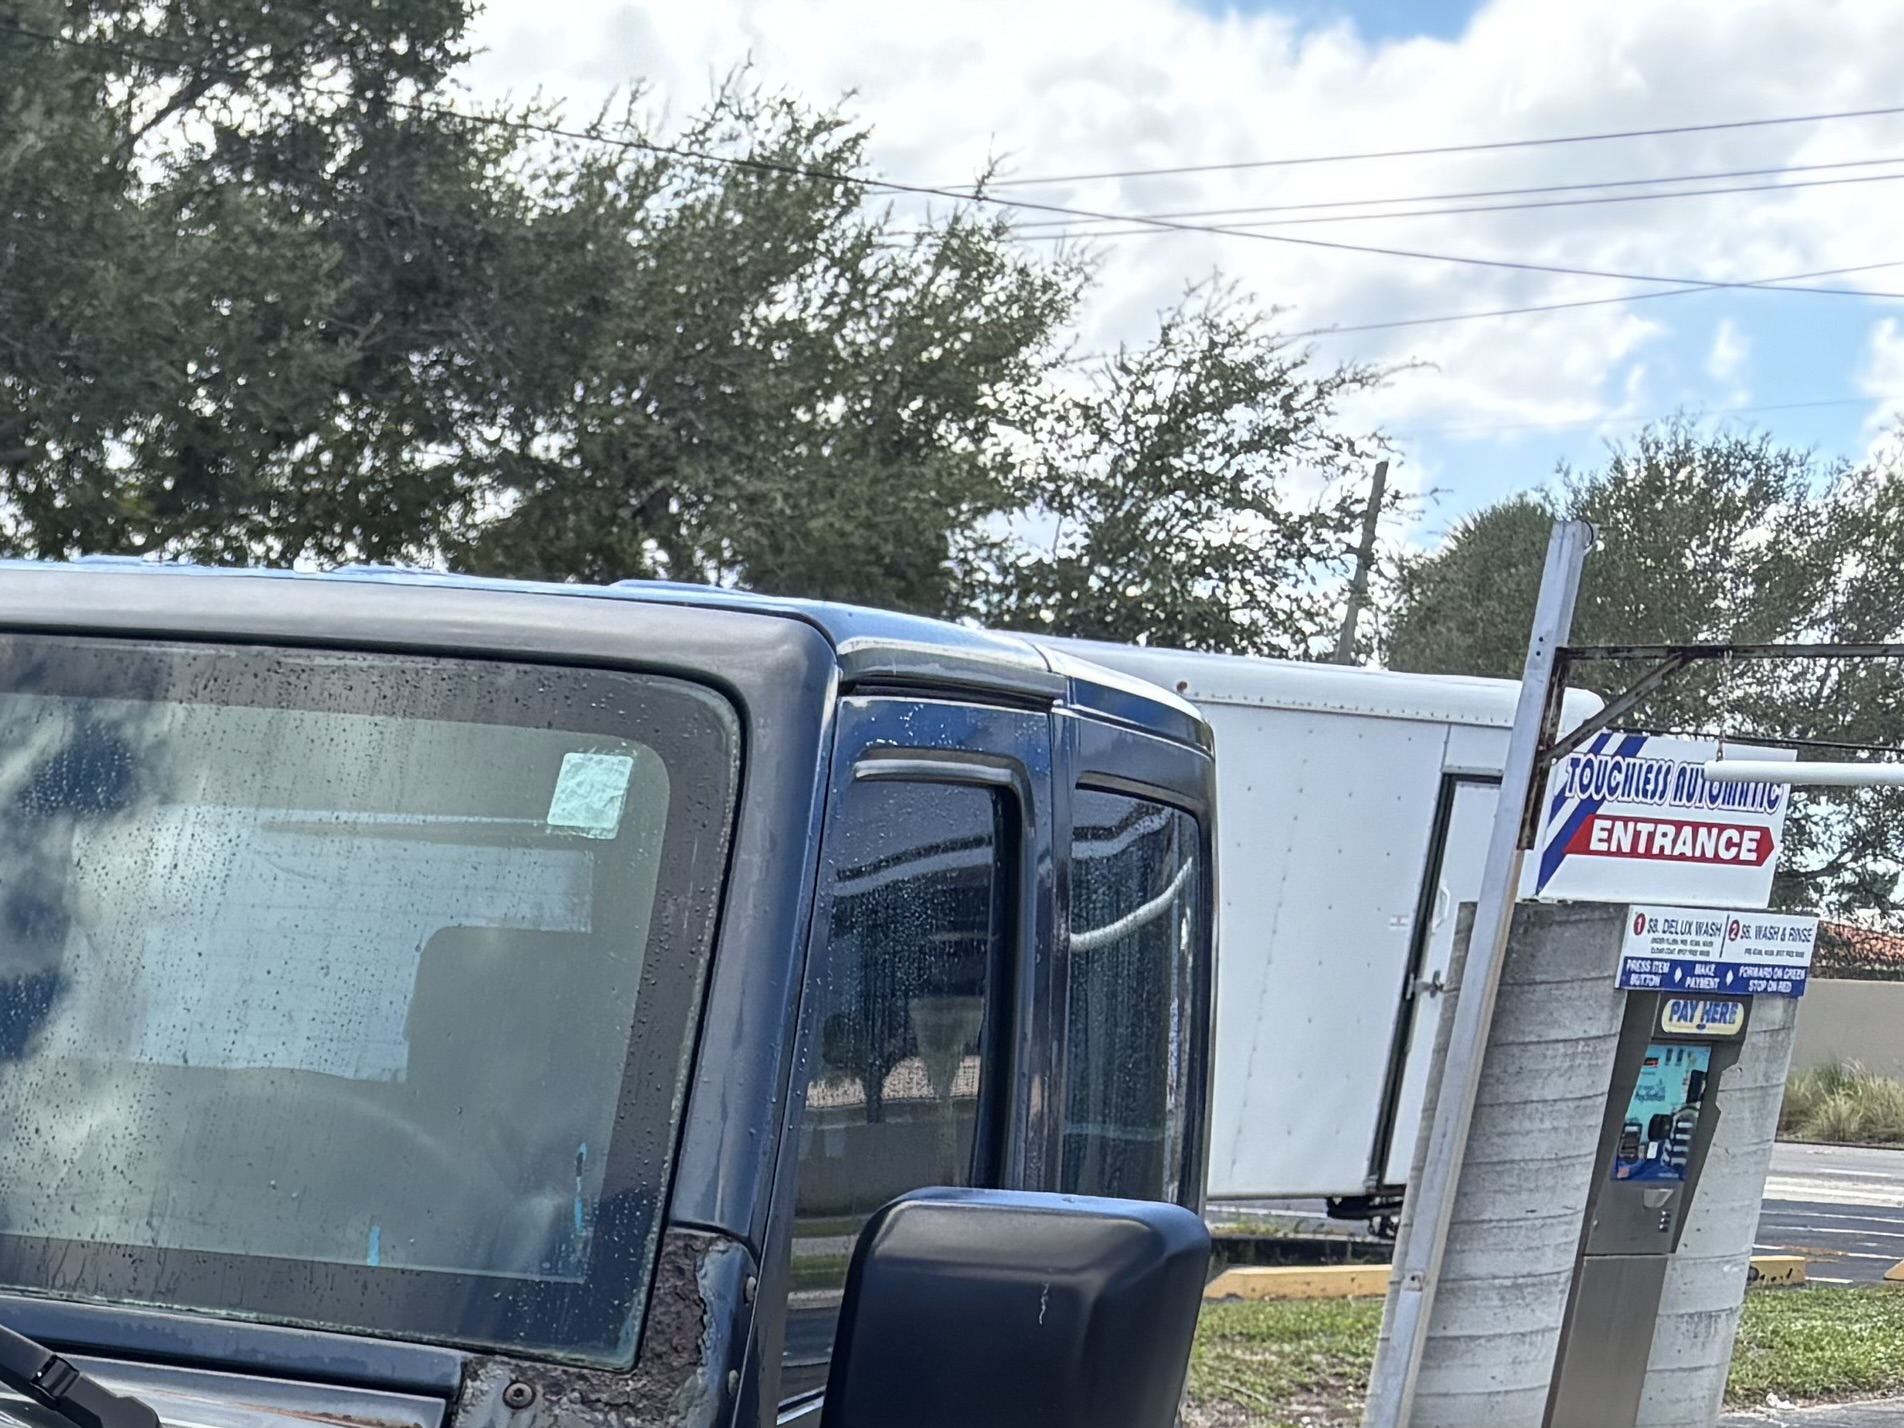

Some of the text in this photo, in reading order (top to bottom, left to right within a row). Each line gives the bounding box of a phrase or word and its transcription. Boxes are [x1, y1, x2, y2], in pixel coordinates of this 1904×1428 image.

[1564, 753, 1673, 806] TOUCHLESS
[1590, 819, 1760, 861] ENTRANCE
[1695, 921, 1723, 937] WASH
[1755, 925, 1780, 941] WASH
[1669, 1001, 1739, 1025] PAY HERE
